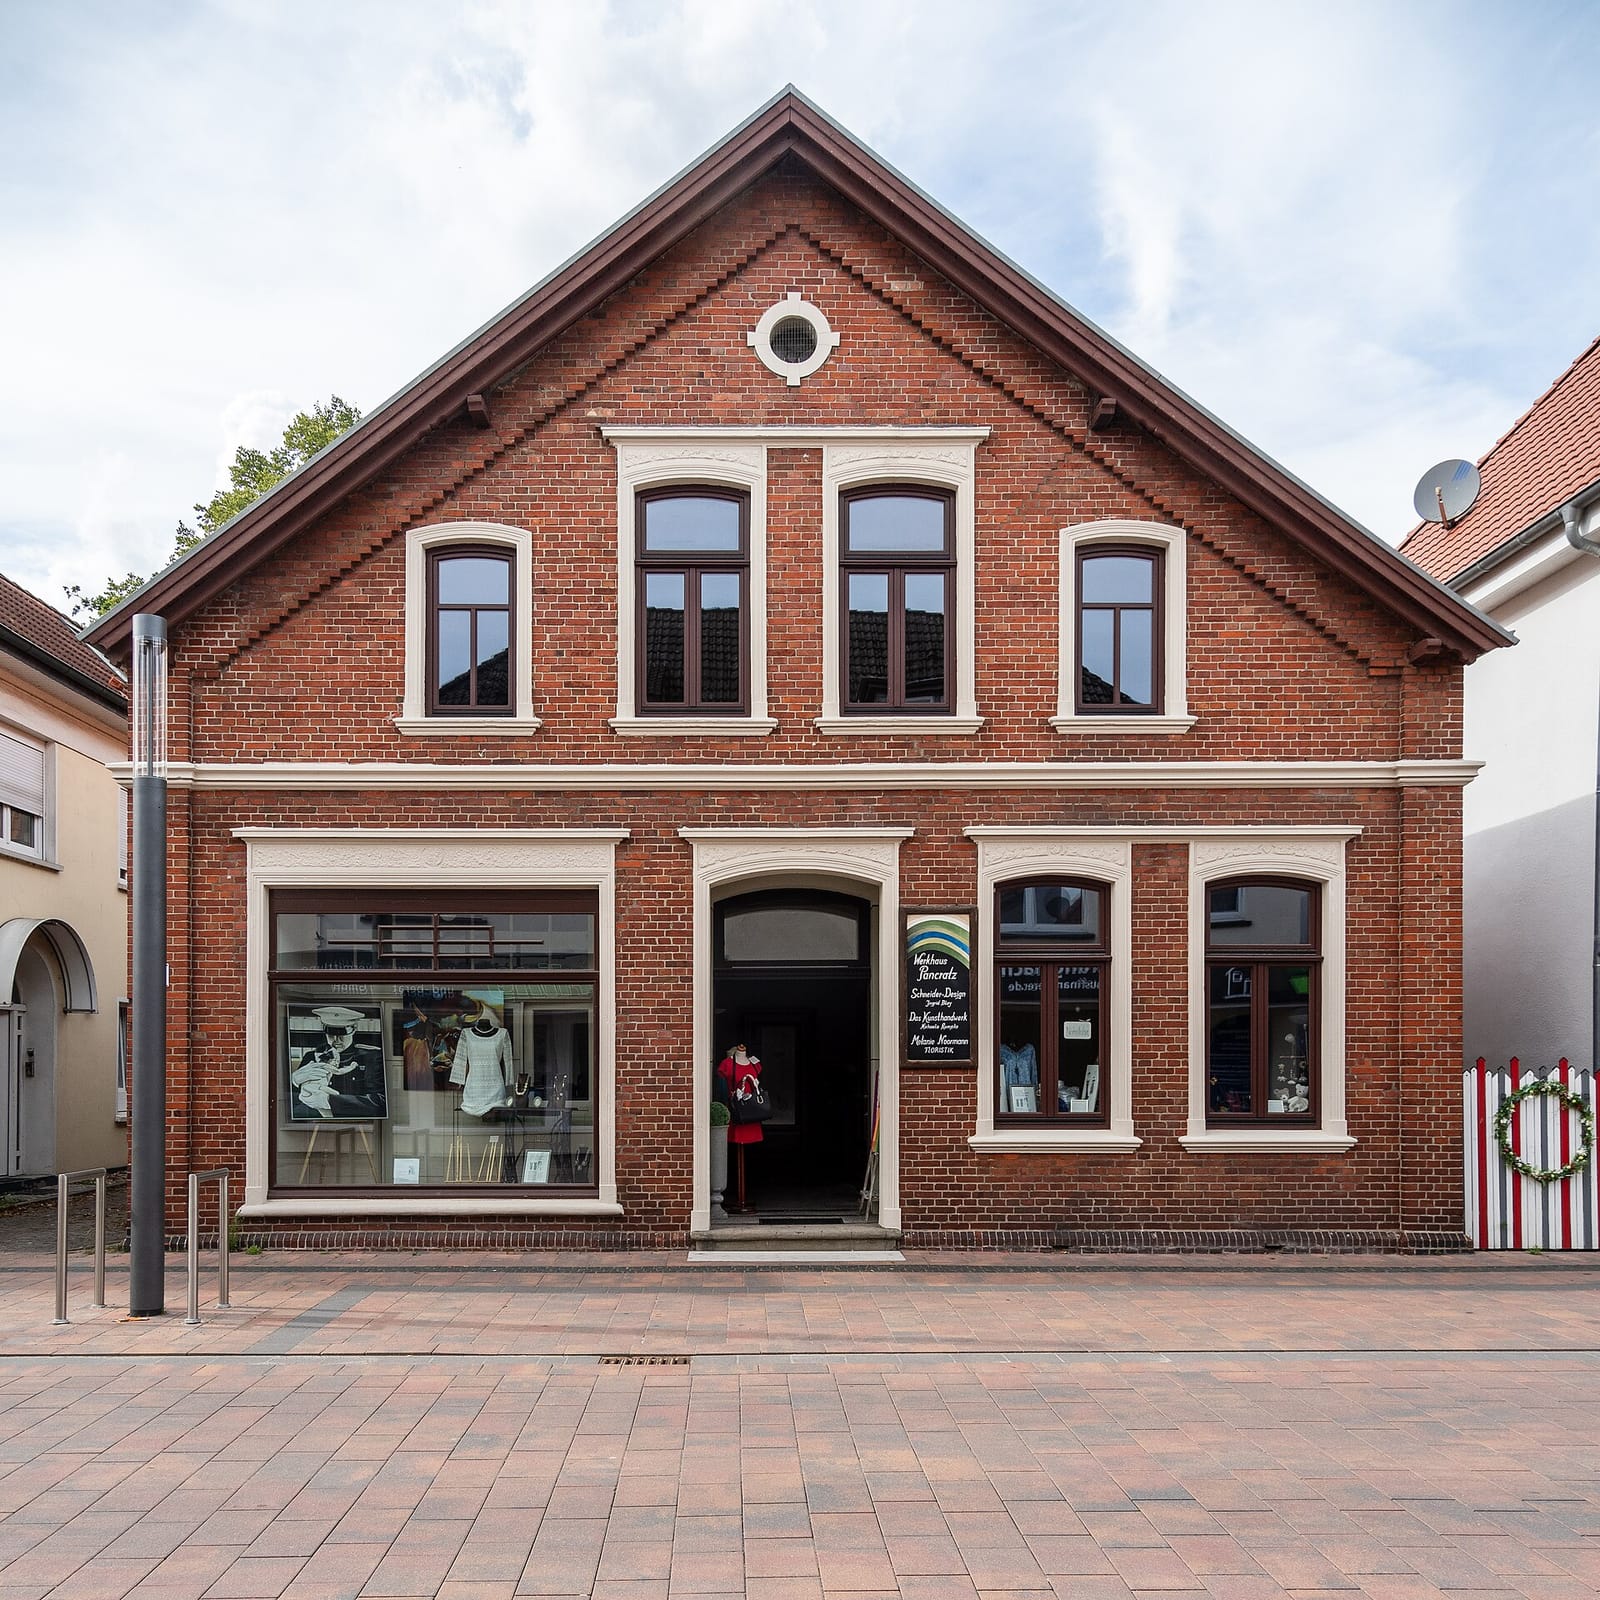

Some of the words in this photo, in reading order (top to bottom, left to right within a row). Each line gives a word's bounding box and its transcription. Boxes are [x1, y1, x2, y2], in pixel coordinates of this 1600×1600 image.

[913, 952, 948, 965] Werkhaus
[917, 965, 957, 981] Pancratz
[911, 987, 966, 999] Schneider-Design
[909, 1011, 921, 1021] Das
[922, 1011, 968, 1023] Kunsthandwerk
[911, 1034, 935, 1046] Melanie
[937, 1034, 969, 1045] Noormann
